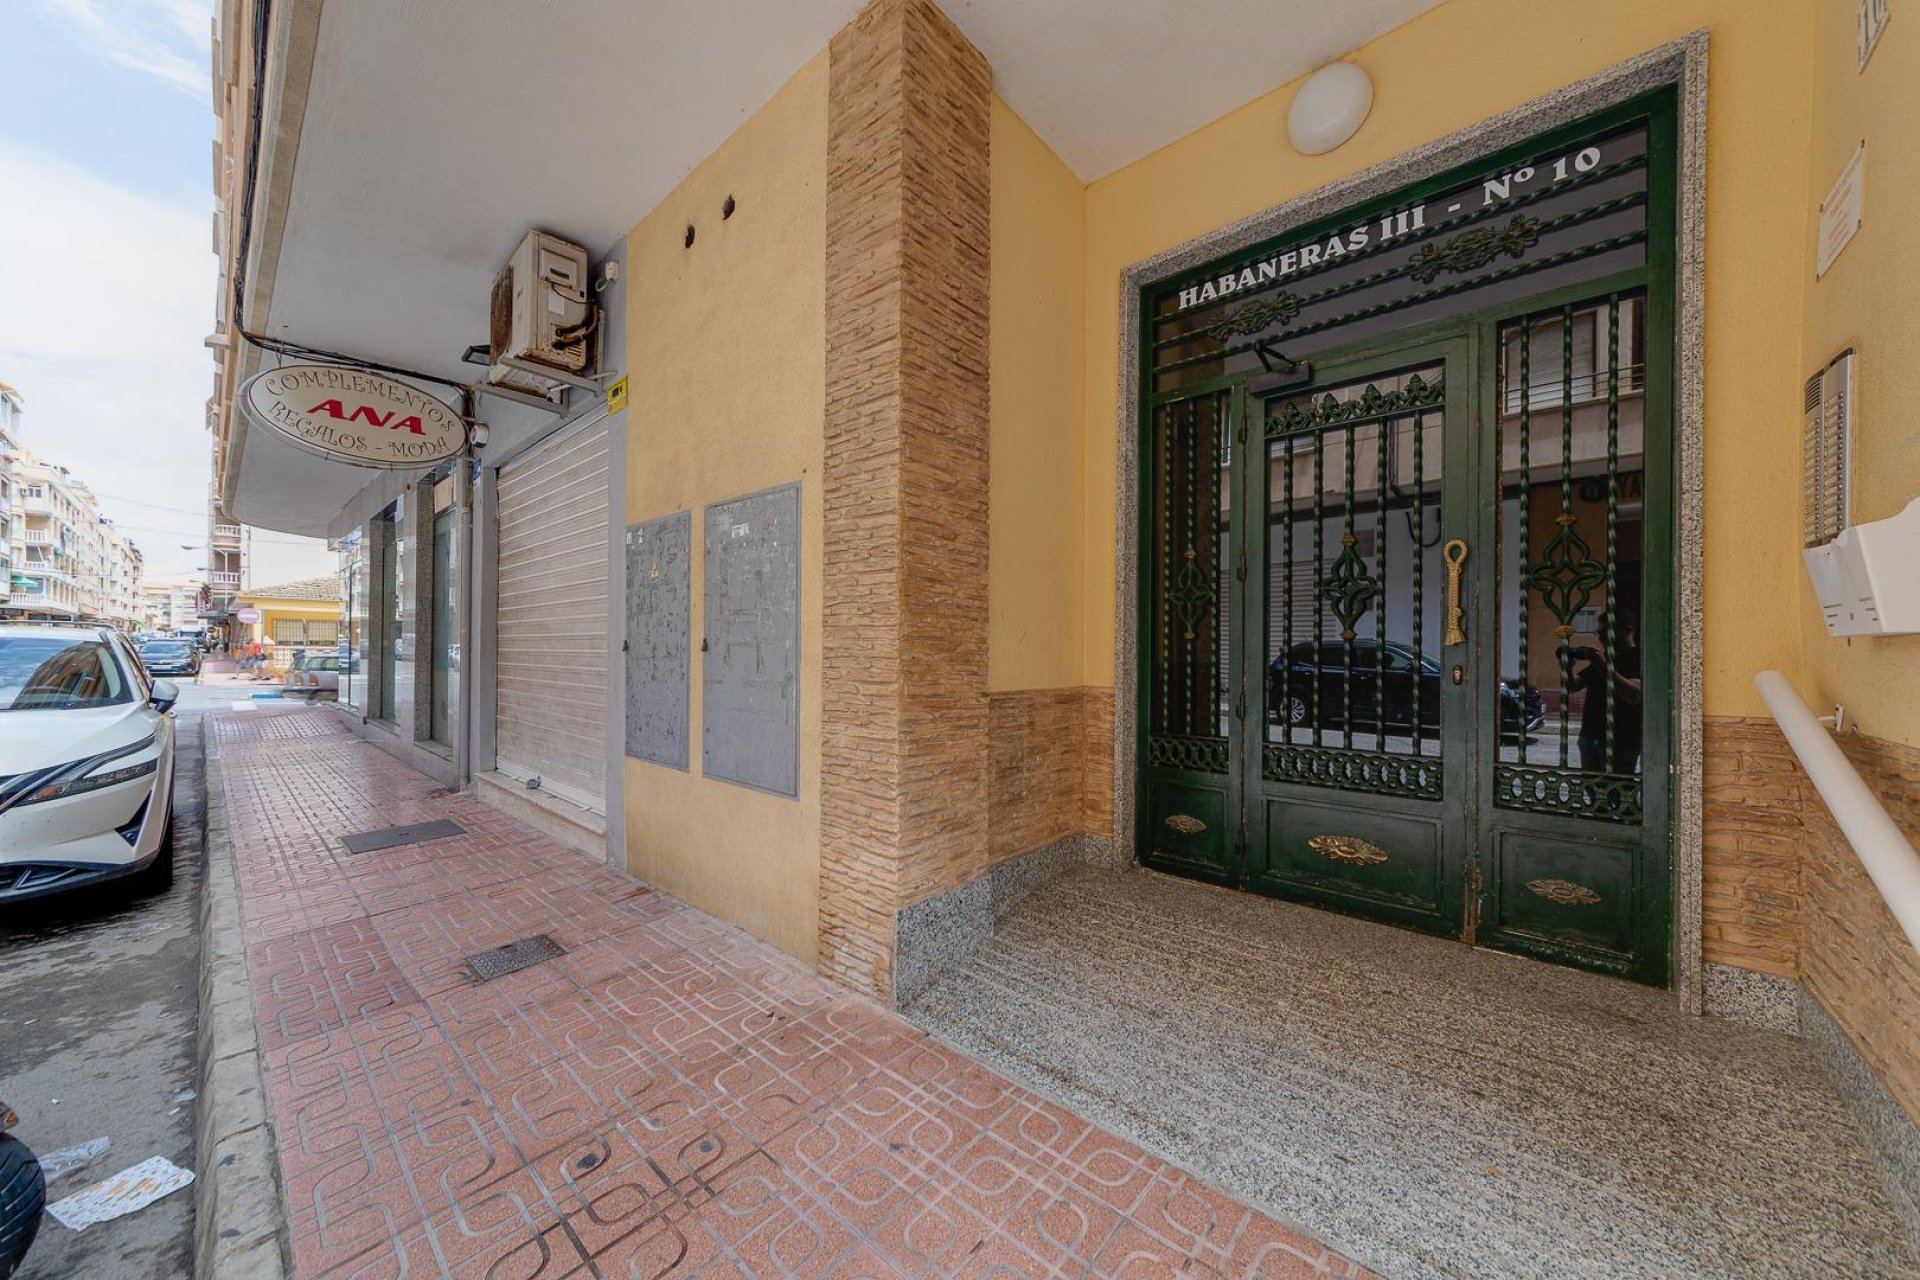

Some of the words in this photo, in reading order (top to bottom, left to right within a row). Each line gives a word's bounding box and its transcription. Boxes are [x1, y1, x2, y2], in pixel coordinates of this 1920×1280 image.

[1178, 225, 1370, 310] HABANERAS
[1380, 204, 1426, 242] III
[1447, 202, 1461, 213] -
[1552, 146, 1602, 182] 10
[265, 370, 455, 432] COMPLEMENTOS
[268, 400, 368, 452] REGALOS
[388, 435, 449, 458] MODA
[306, 399, 426, 436] ANA
